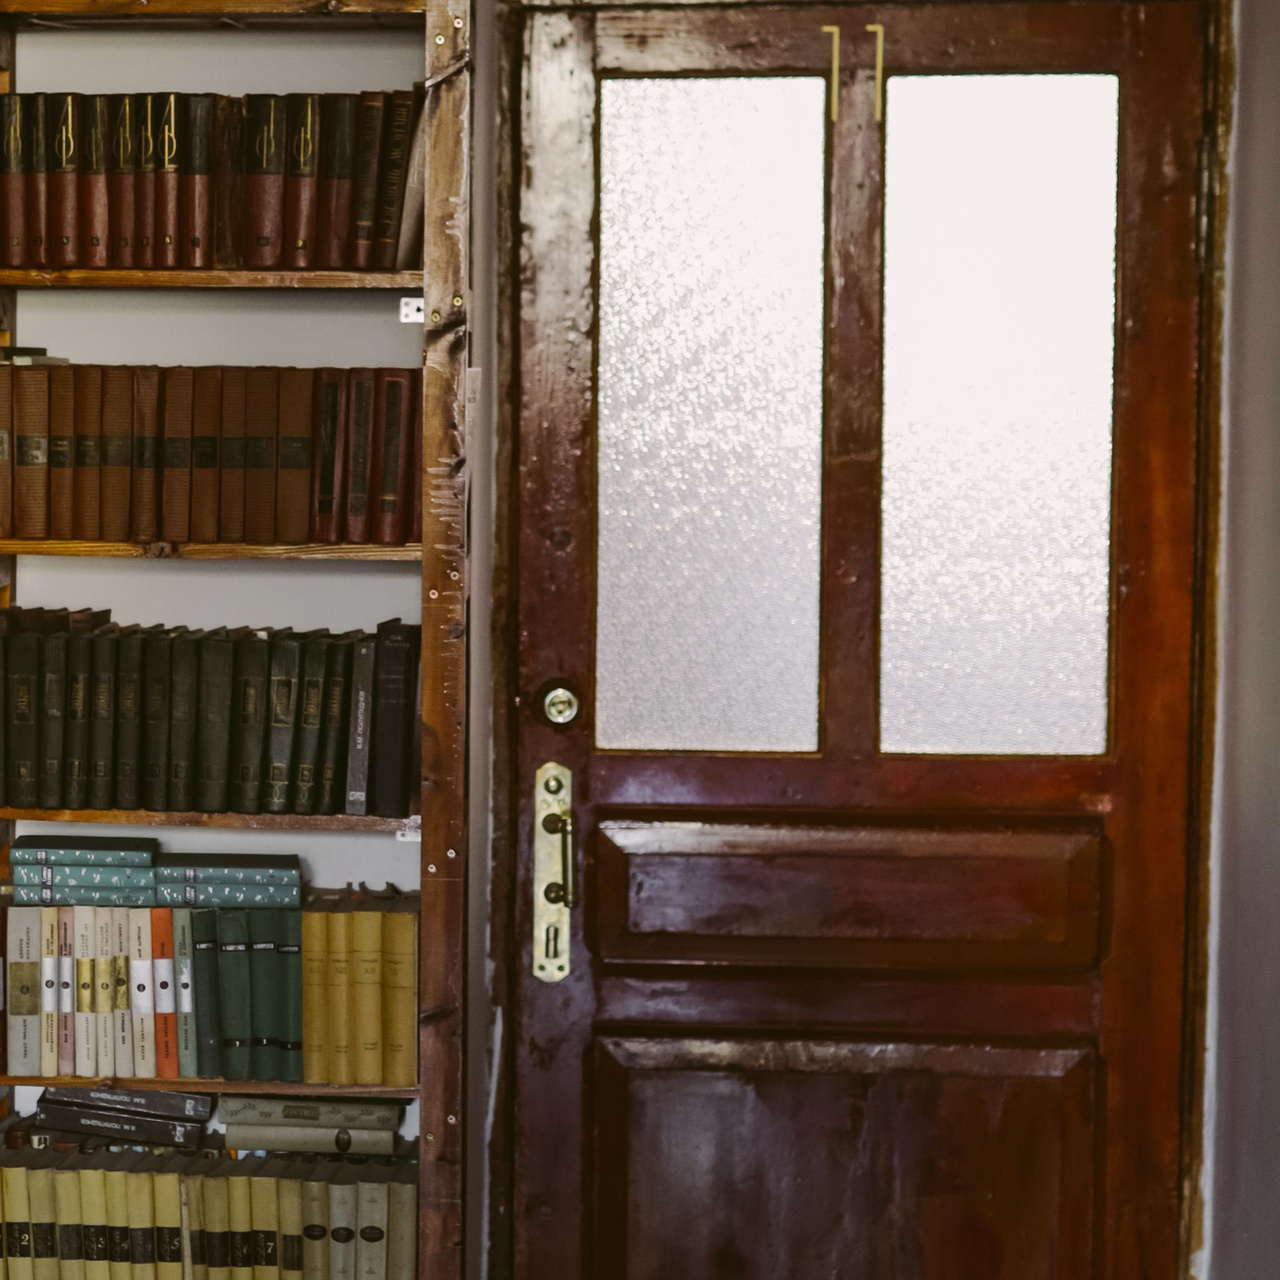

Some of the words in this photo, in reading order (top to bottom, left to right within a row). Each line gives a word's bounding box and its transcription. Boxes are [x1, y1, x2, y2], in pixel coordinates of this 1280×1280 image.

[21, 1233, 29, 1245] 2
[98, 1237, 106, 1249] 3
[171, 1238, 181, 1250] 5
[267, 1242, 275, 1253] 7
